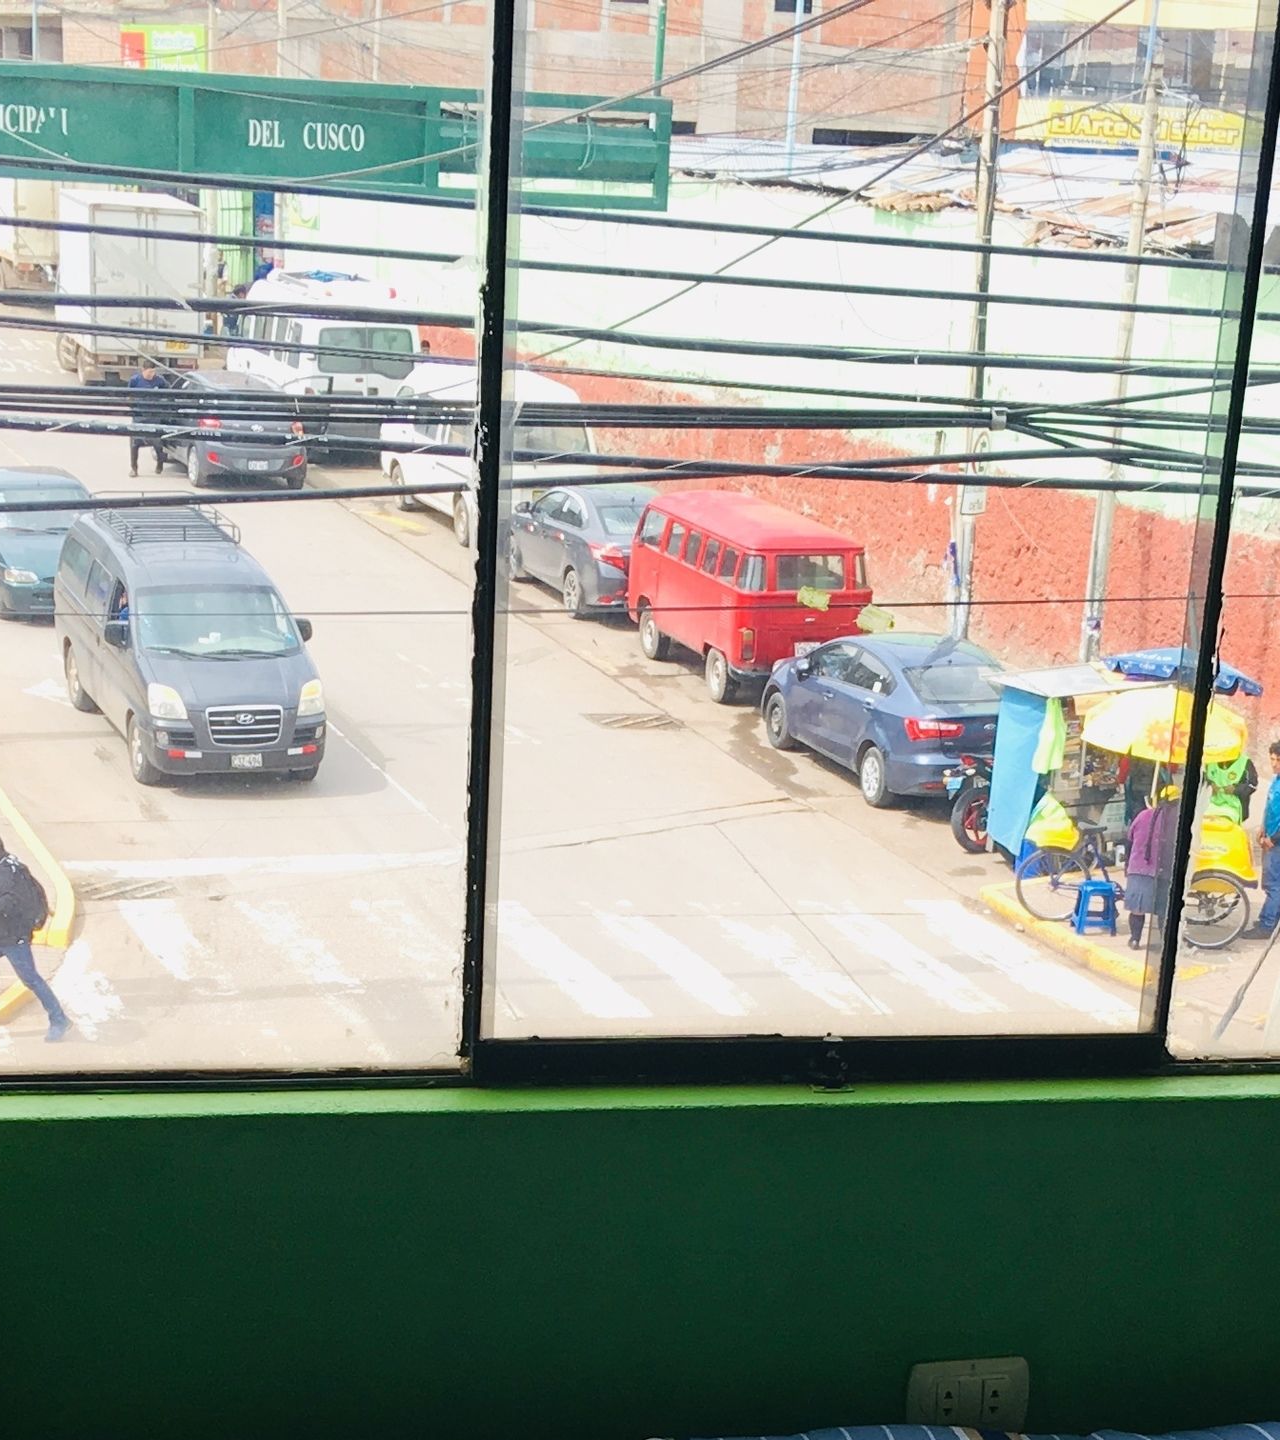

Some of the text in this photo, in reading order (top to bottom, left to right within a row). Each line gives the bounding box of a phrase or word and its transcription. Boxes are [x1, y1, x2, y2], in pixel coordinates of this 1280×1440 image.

[248, 119, 285, 148] DEL
[303, 122, 365, 152] CUSCO
[1048, 113, 1074, 135] El
[1074, 114, 1129, 138] Arte
[1169, 121, 1239, 145] Saber
